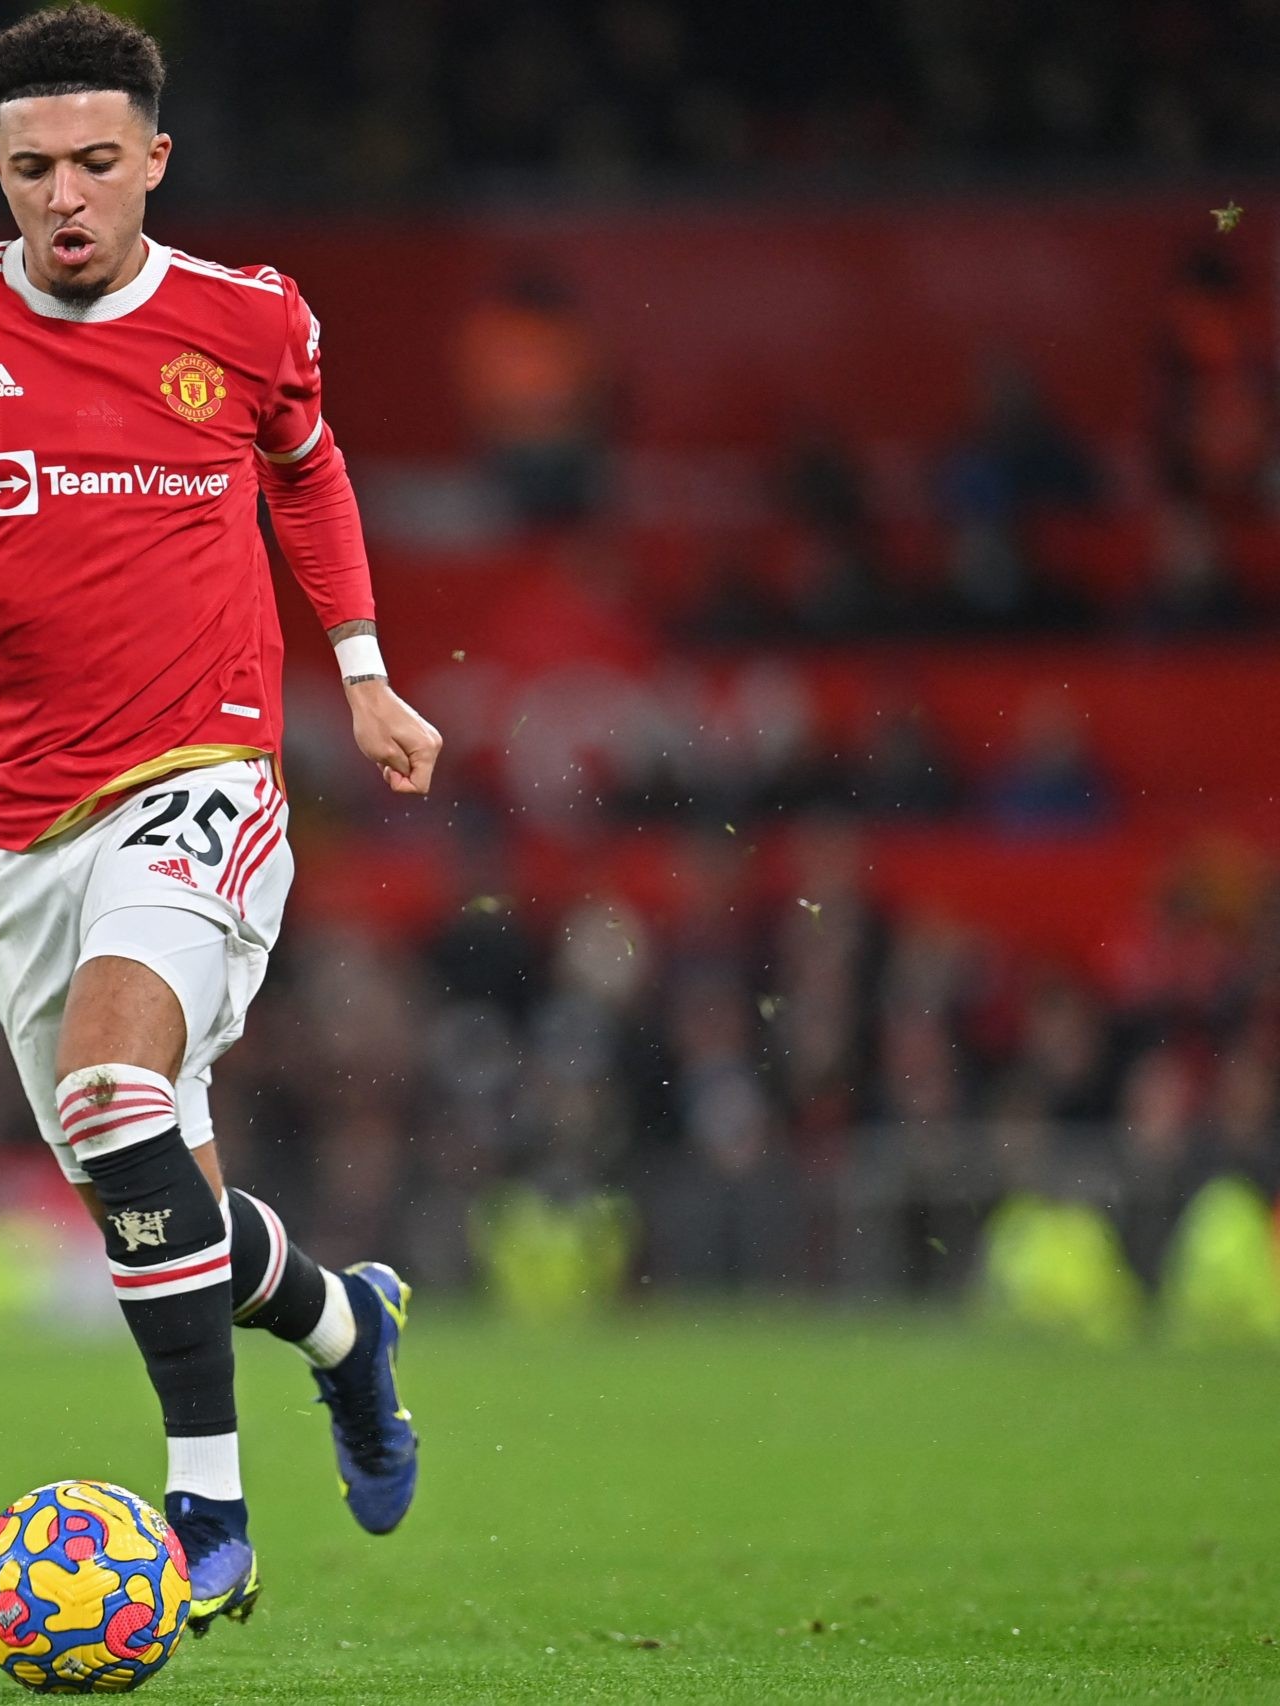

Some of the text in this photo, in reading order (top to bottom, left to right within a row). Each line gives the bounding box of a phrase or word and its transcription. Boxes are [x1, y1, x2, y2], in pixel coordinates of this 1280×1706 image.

[165, 358, 220, 381] MANCHESTER
[177, 404, 214, 417] UNITED
[41, 464, 230, 497] TeamViewer
[117, 788, 239, 867] 25
[148, 863, 199, 889] adidas
